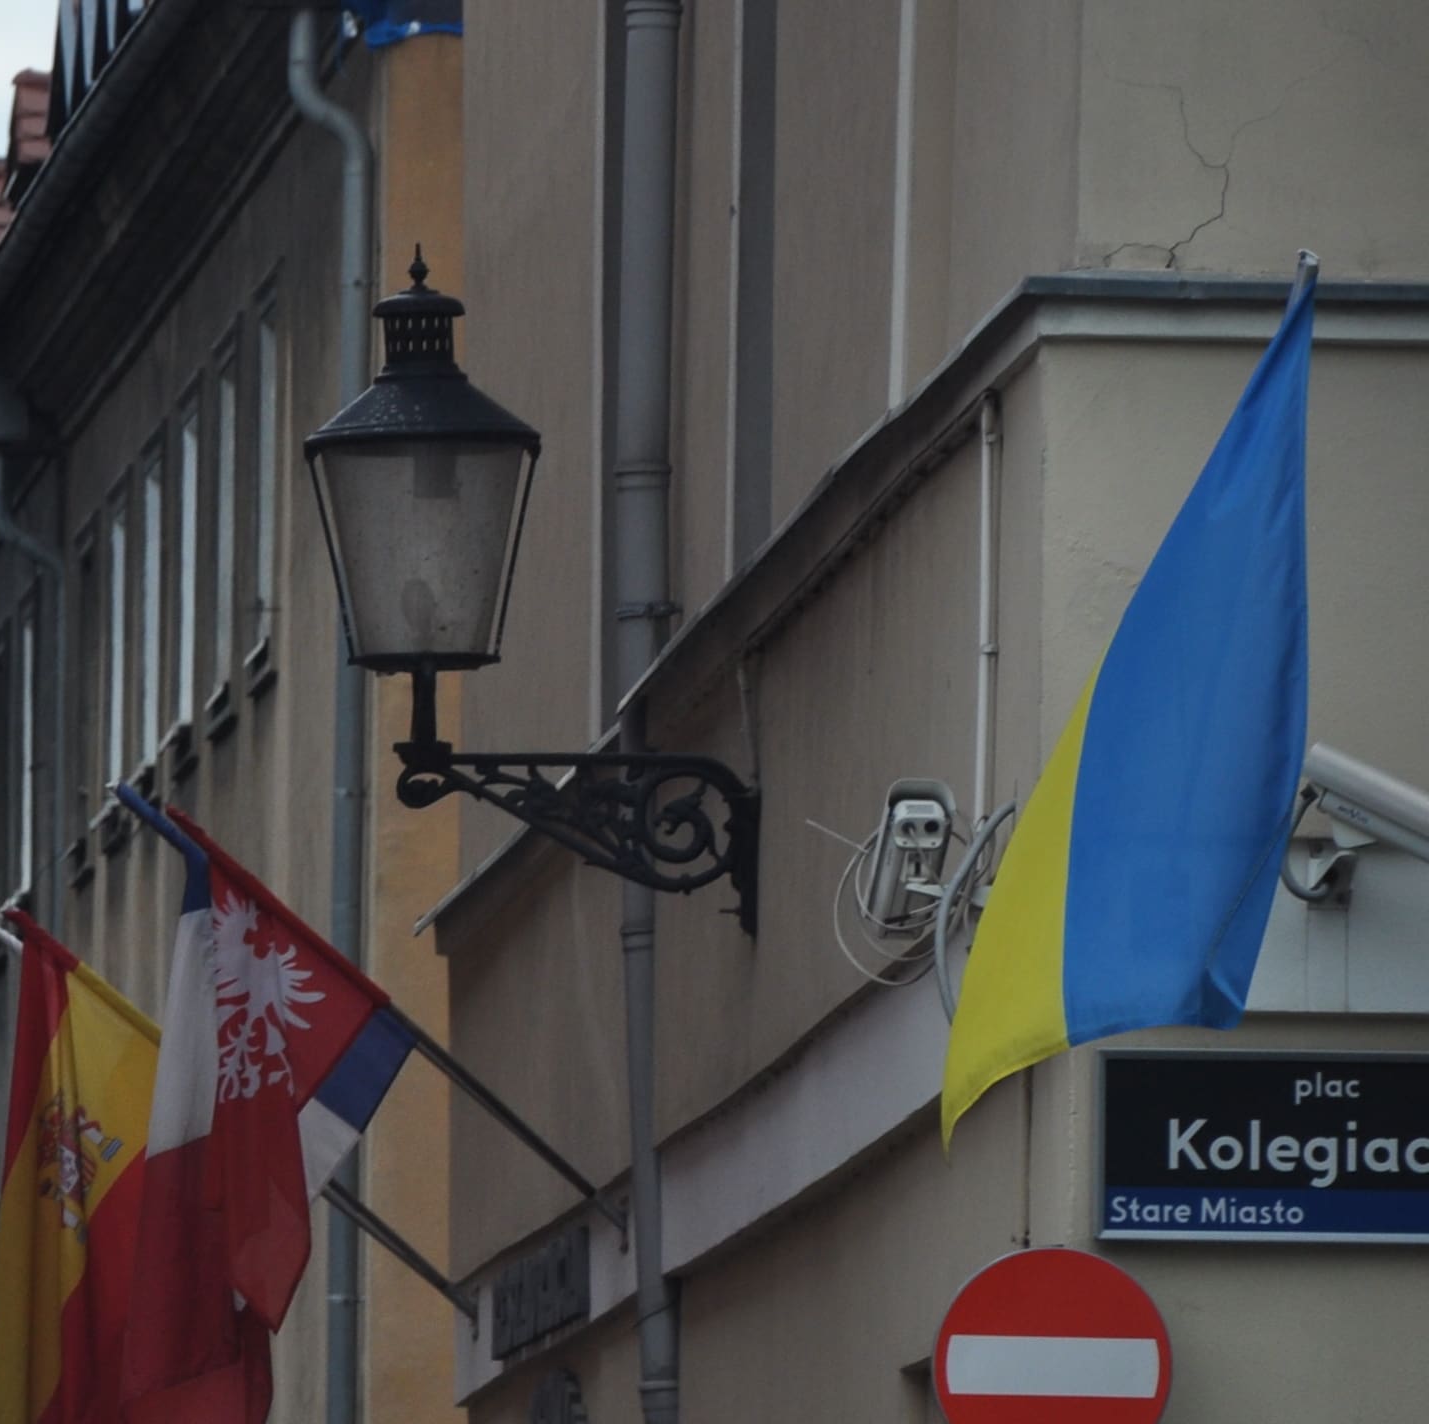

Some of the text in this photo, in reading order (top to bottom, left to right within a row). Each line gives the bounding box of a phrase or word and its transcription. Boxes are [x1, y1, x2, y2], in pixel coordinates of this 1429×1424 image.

[1294, 1072, 1361, 1106] plac
[1110, 1196, 1305, 1226] Stare Miasto
